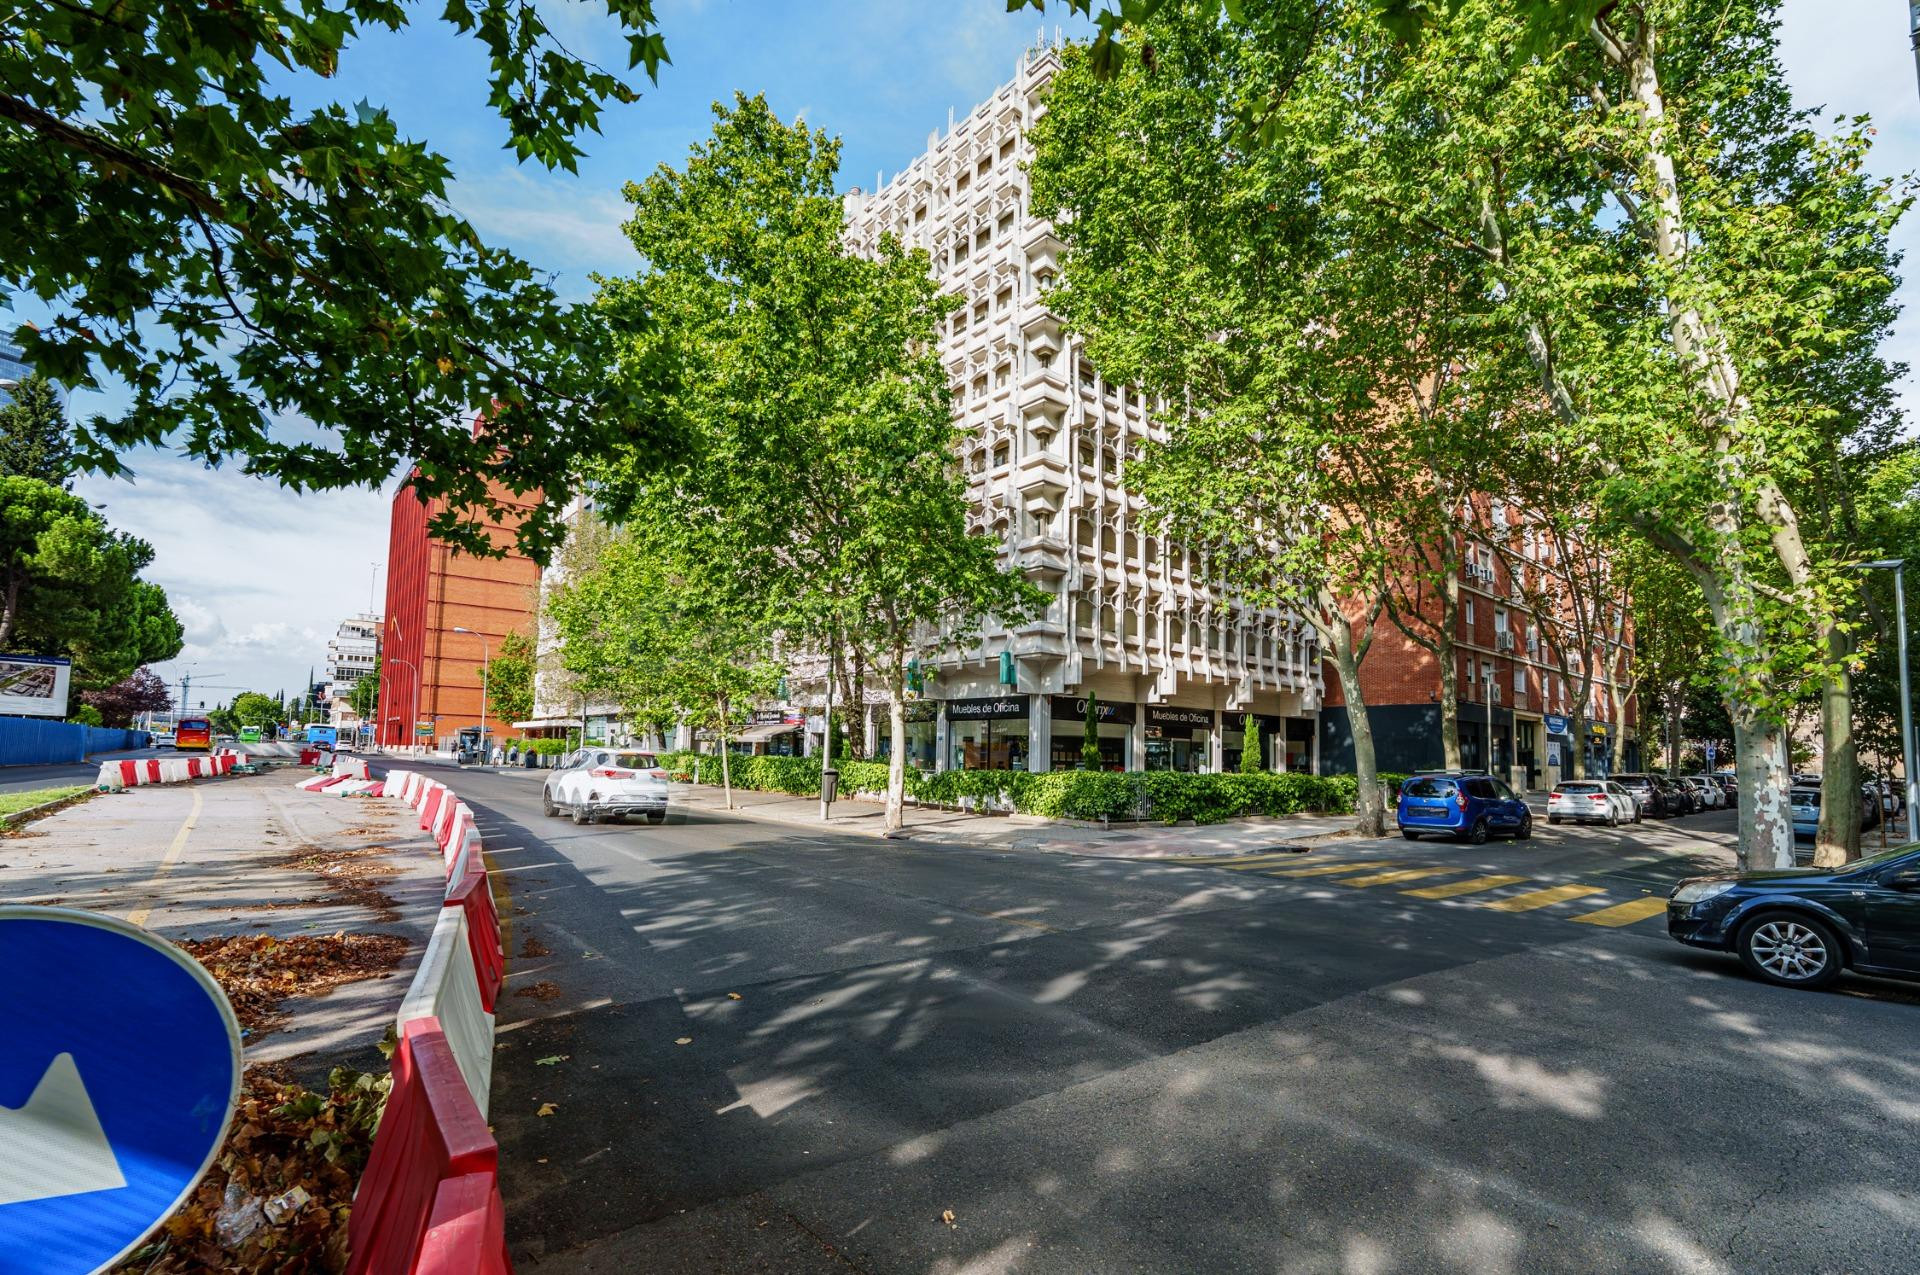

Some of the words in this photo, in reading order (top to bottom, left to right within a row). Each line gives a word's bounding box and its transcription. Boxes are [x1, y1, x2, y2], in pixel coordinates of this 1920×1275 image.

[952, 704, 981, 714] Muebles
[982, 703, 992, 713] de
[993, 702, 1020, 713] Oficina
[1152, 710, 1179, 721] Muebles
[1179, 713, 1188, 722] de
[1188, 713, 1209, 724] Oficina
